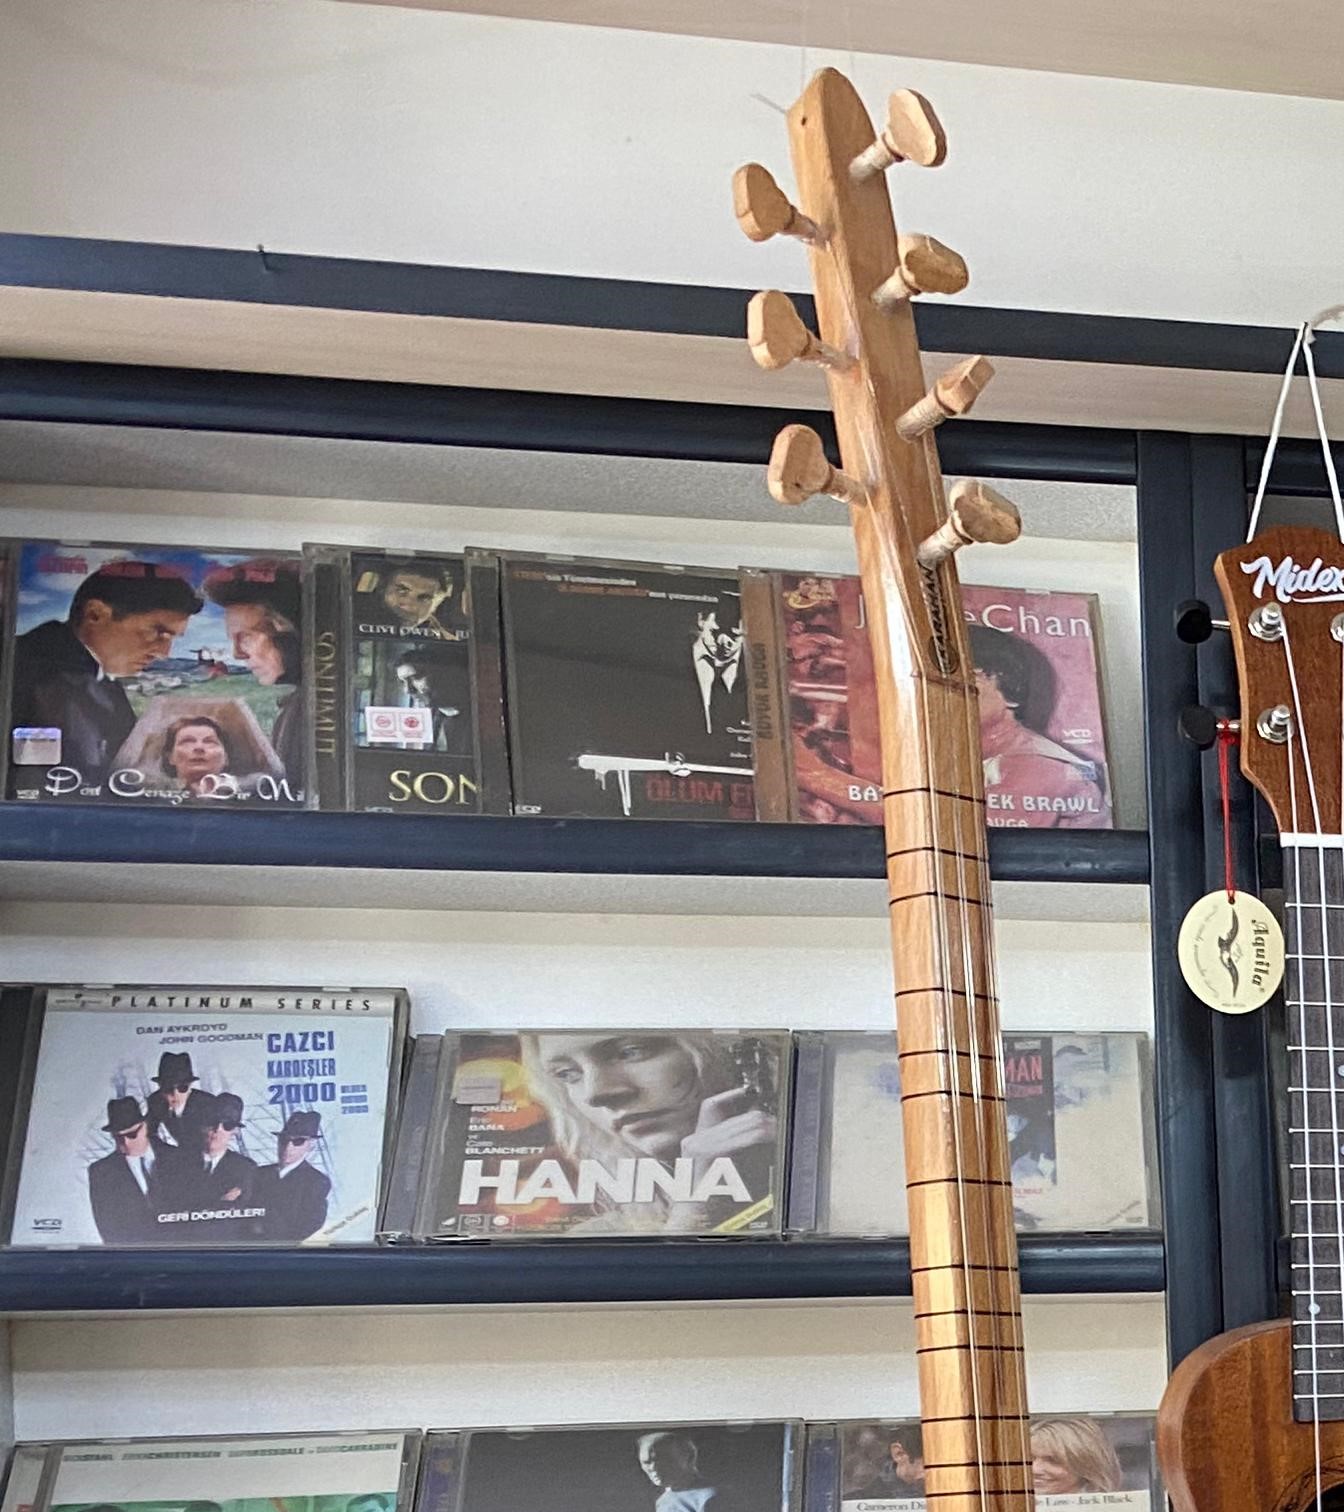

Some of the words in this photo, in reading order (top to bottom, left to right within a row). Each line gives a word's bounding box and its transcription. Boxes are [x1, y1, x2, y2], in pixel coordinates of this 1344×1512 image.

[981, 603, 1091, 639] Chan
[1023, 795, 1099, 814] BRAWL
[112, 996, 253, 1009] PLATINUM
[278, 997, 372, 1011] SERIES
[267, 1082, 336, 1105] 2000
[458, 1157, 753, 1205] HANNA
